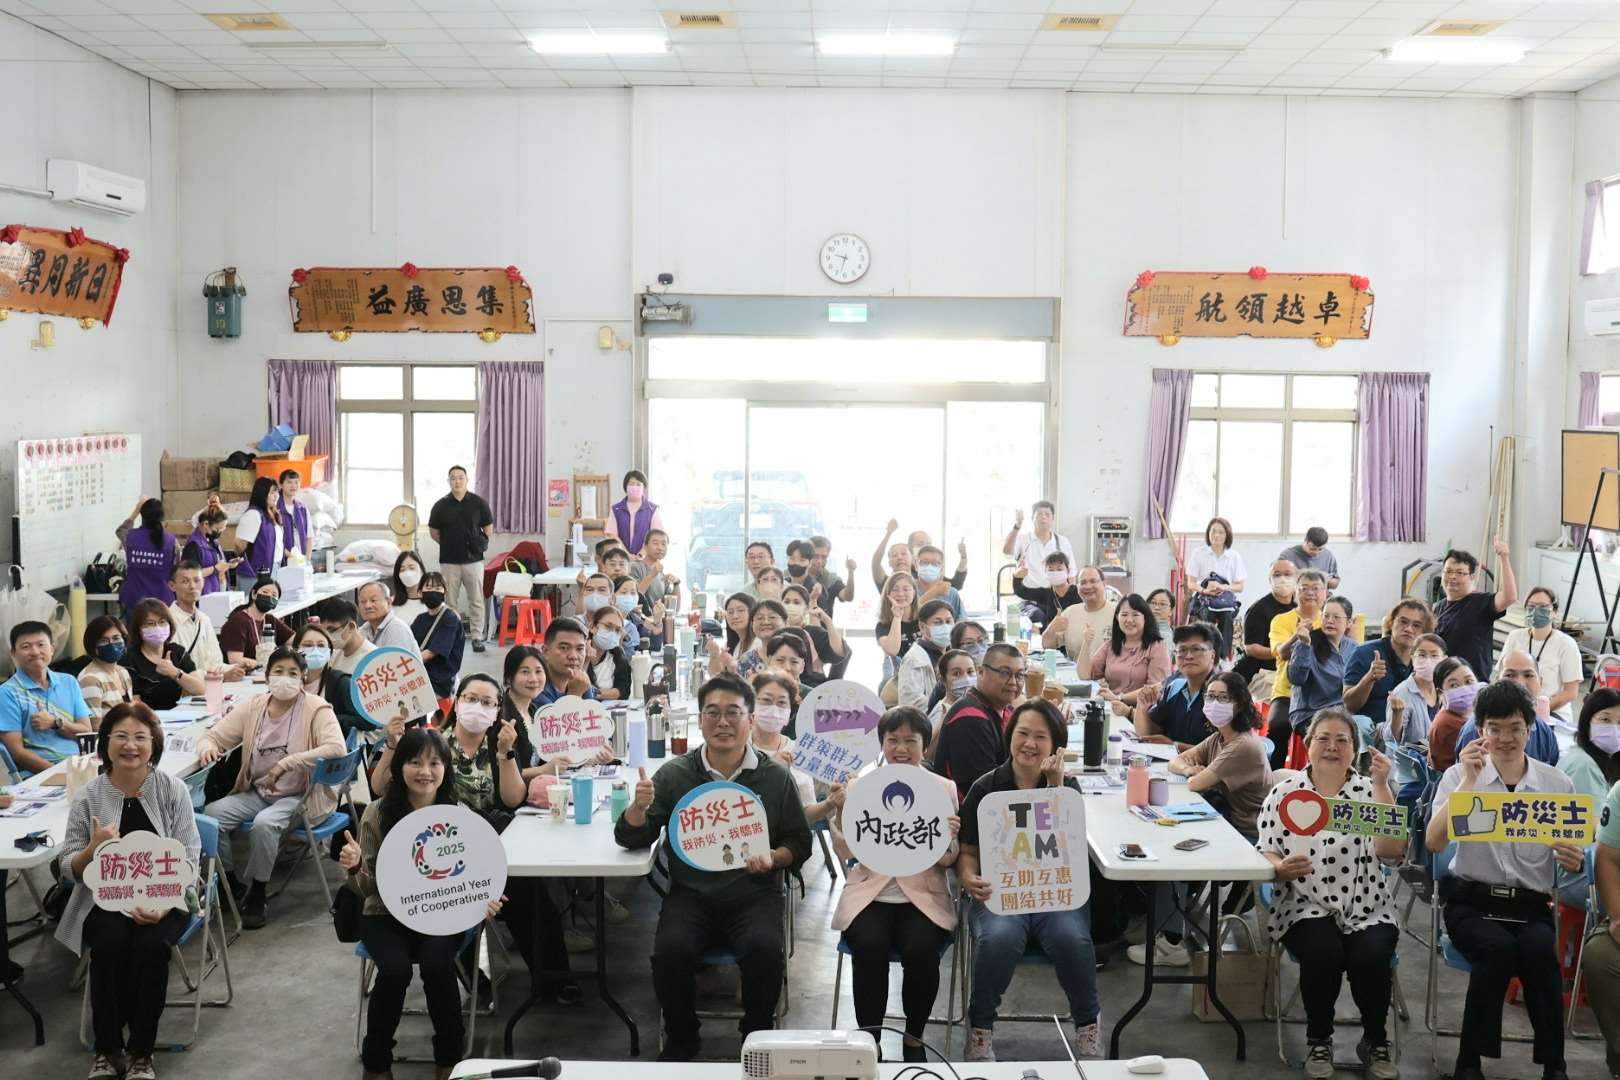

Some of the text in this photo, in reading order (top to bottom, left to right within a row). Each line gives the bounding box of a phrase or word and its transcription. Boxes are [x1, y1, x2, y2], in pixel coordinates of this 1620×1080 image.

[355, 656, 416, 699] 防災士
[540, 709, 602, 740] 防災士
[798, 731, 864, 771] 群策群力
[679, 795, 756, 834] 防災士
[1332, 801, 1404, 827] 防災士
[1501, 799, 1588, 826] 防災士
[436, 842, 466, 858] 2025
[99, 850, 181, 881] 防災士
[1000, 865, 1074, 889] 互助互惠
[400, 877, 493, 905] International Year
[407, 891, 491, 917] of Cooperatives
[1001, 888, 1075, 912] 團結共好
